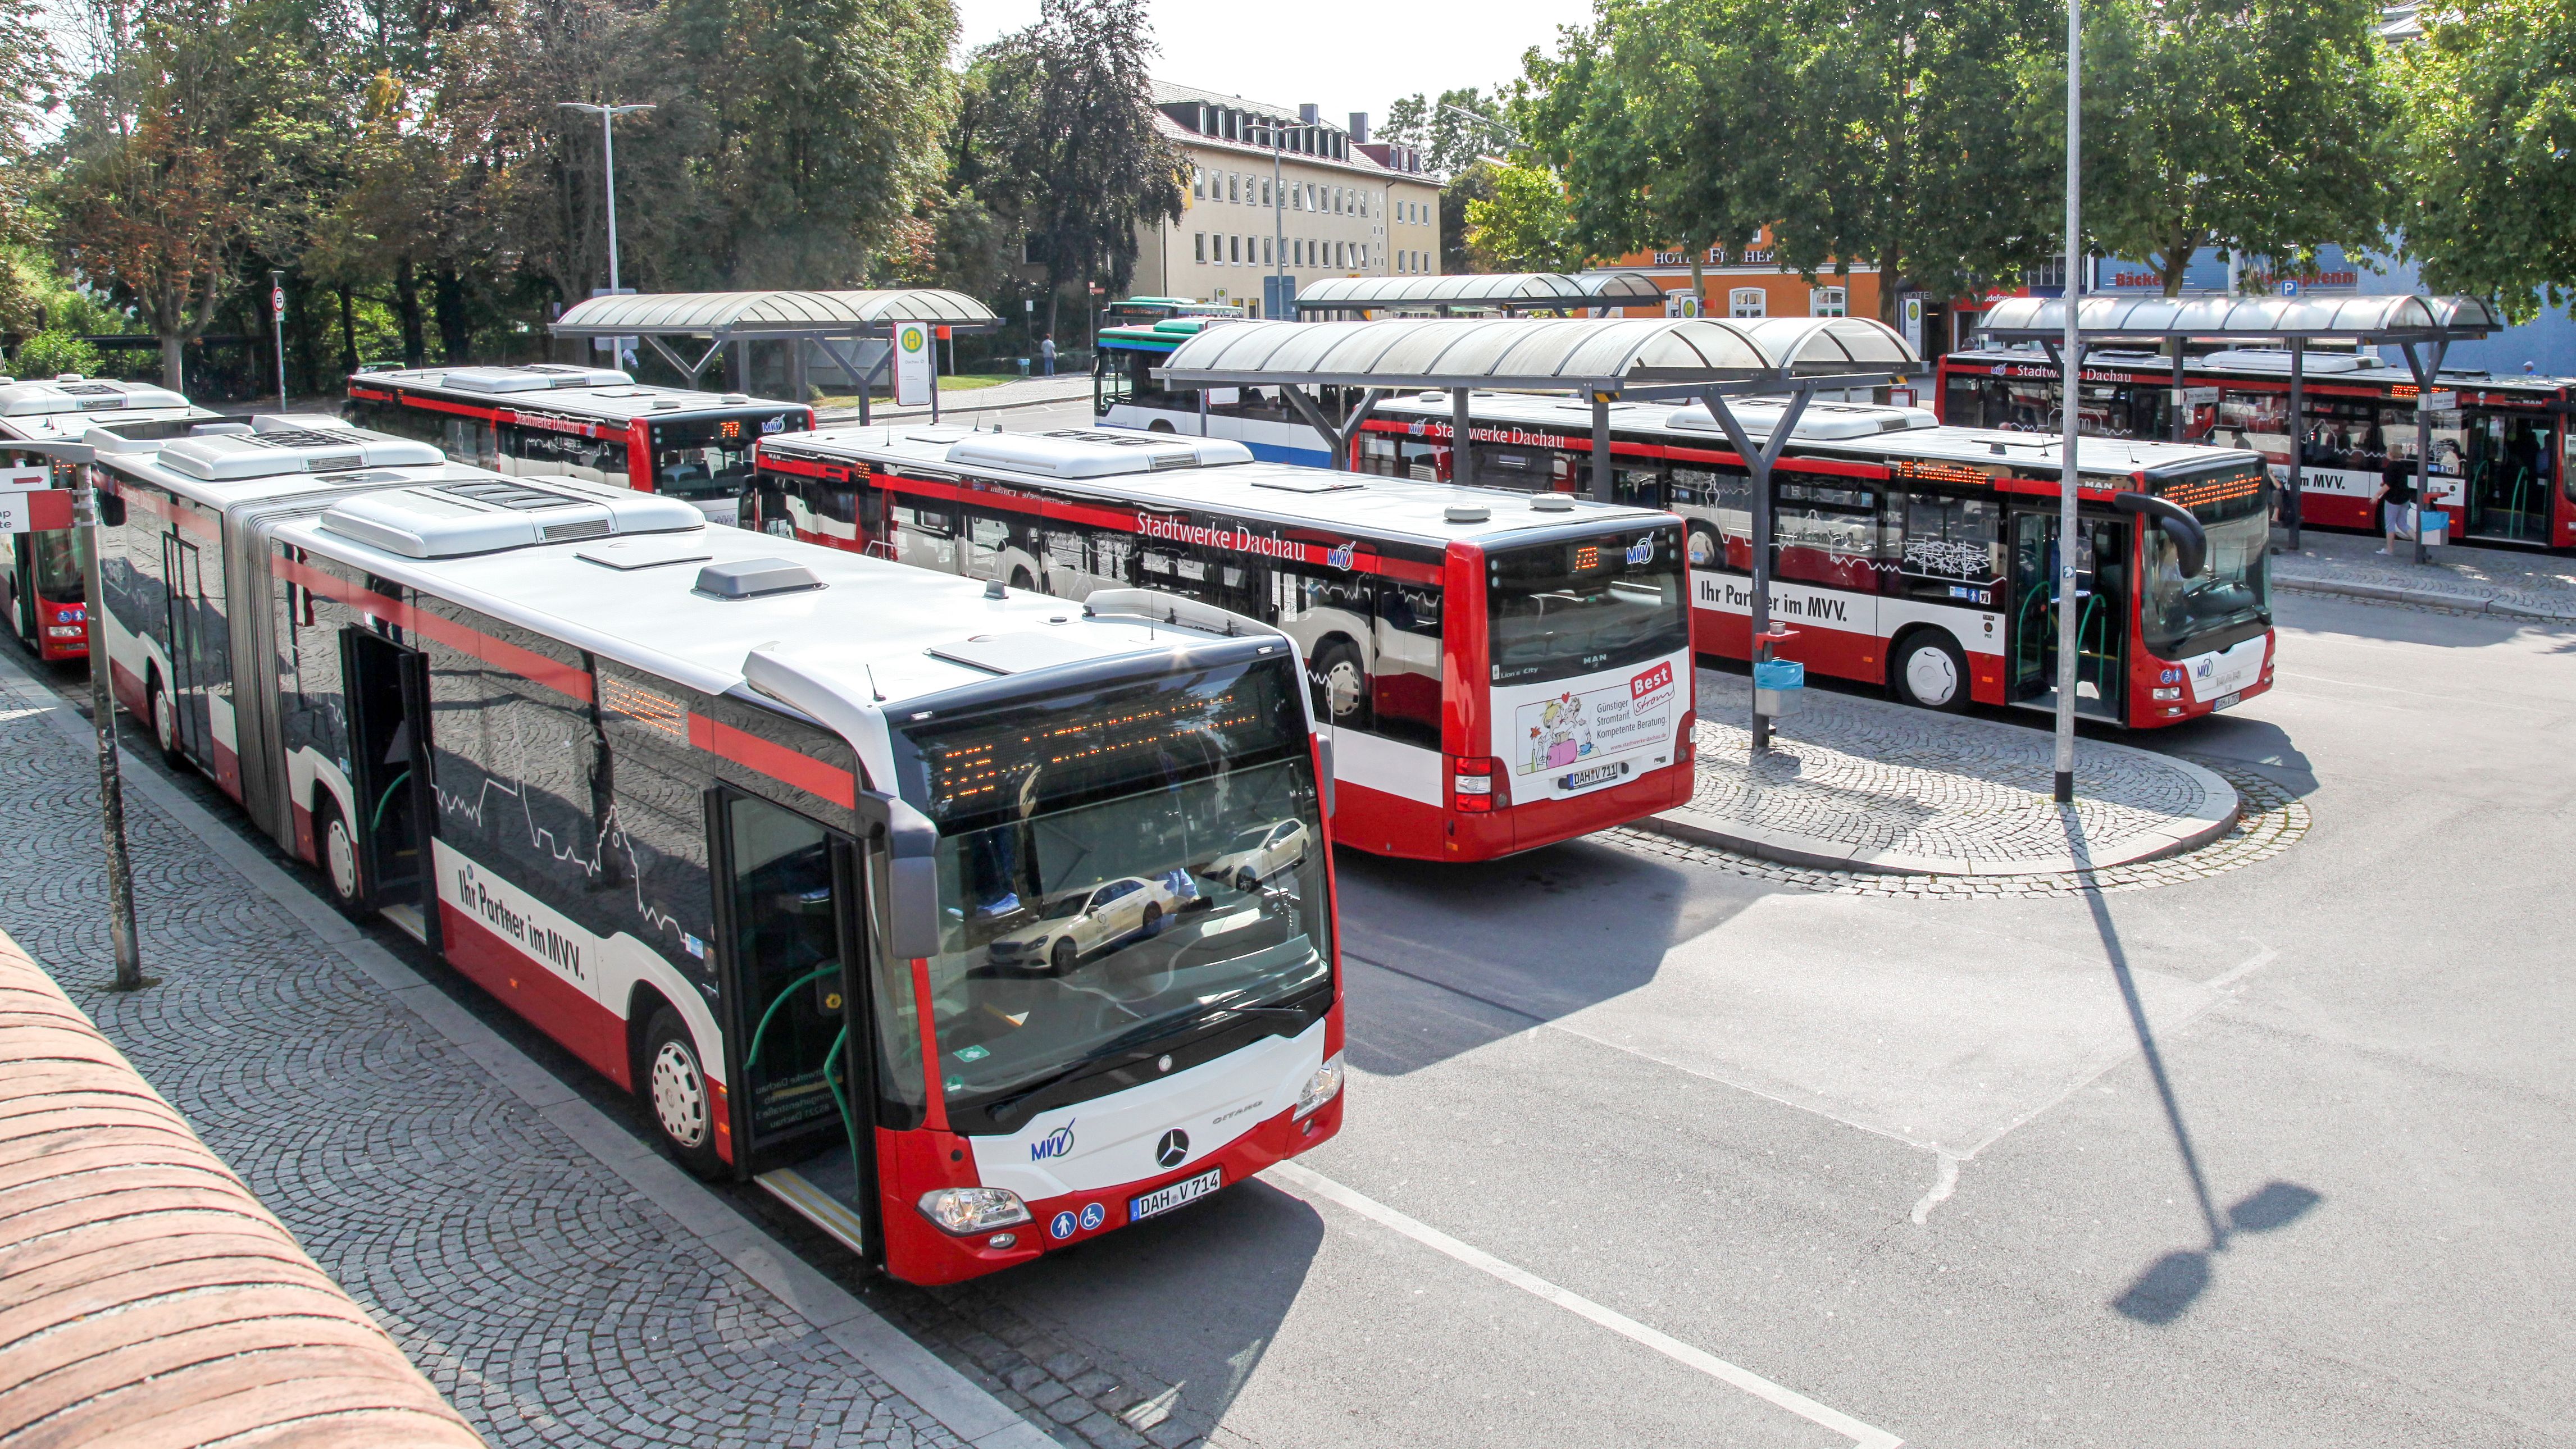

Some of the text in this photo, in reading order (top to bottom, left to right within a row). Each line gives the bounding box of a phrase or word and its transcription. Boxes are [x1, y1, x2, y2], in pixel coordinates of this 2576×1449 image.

[2284, 283, 2293, 295] P
[908, 333, 917, 347] H
[2086, 368, 2131, 382] Dachau
[515, 411, 552, 430] Stadtwerke
[553, 417, 580, 434] Dachau
[1435, 421, 1508, 443] Stawerke
[1512, 426, 1565, 448] Dachau
[2085, 481, 2113, 490] MAN
[2313, 474, 2345, 490] MVV.
[1137, 512, 1306, 562] Stadtwerke Dachau
[1626, 531, 1654, 564] MVV
[1327, 541, 1357, 571] MVV
[1701, 580, 1847, 622] Ihr Parter im MVV.
[1583, 654, 1606, 664] MAN
[2197, 654, 2213, 678] MVV
[1634, 668, 1669, 695] Best
[1597, 700, 1628, 713] Günstiger
[1635, 690, 1674, 713] Strom
[1597, 710, 1631, 726] Stromtarif.
[1597, 716, 1667, 739] Kompetente Beratung.
[1610, 733, 1667, 750] www.stadtwerke-dachau.de
[1574, 770, 1590, 785] DAH
[1595, 768, 1600, 779] V
[1601, 764, 1616, 777] 711
[458, 869, 585, 981] Ihr Partner im MVV.
[1031, 1118, 1076, 1161] MVV
[1141, 1190, 1170, 1215] DAH
[1180, 1184, 1189, 1200] V
[1192, 1172, 1218, 1196] 714
